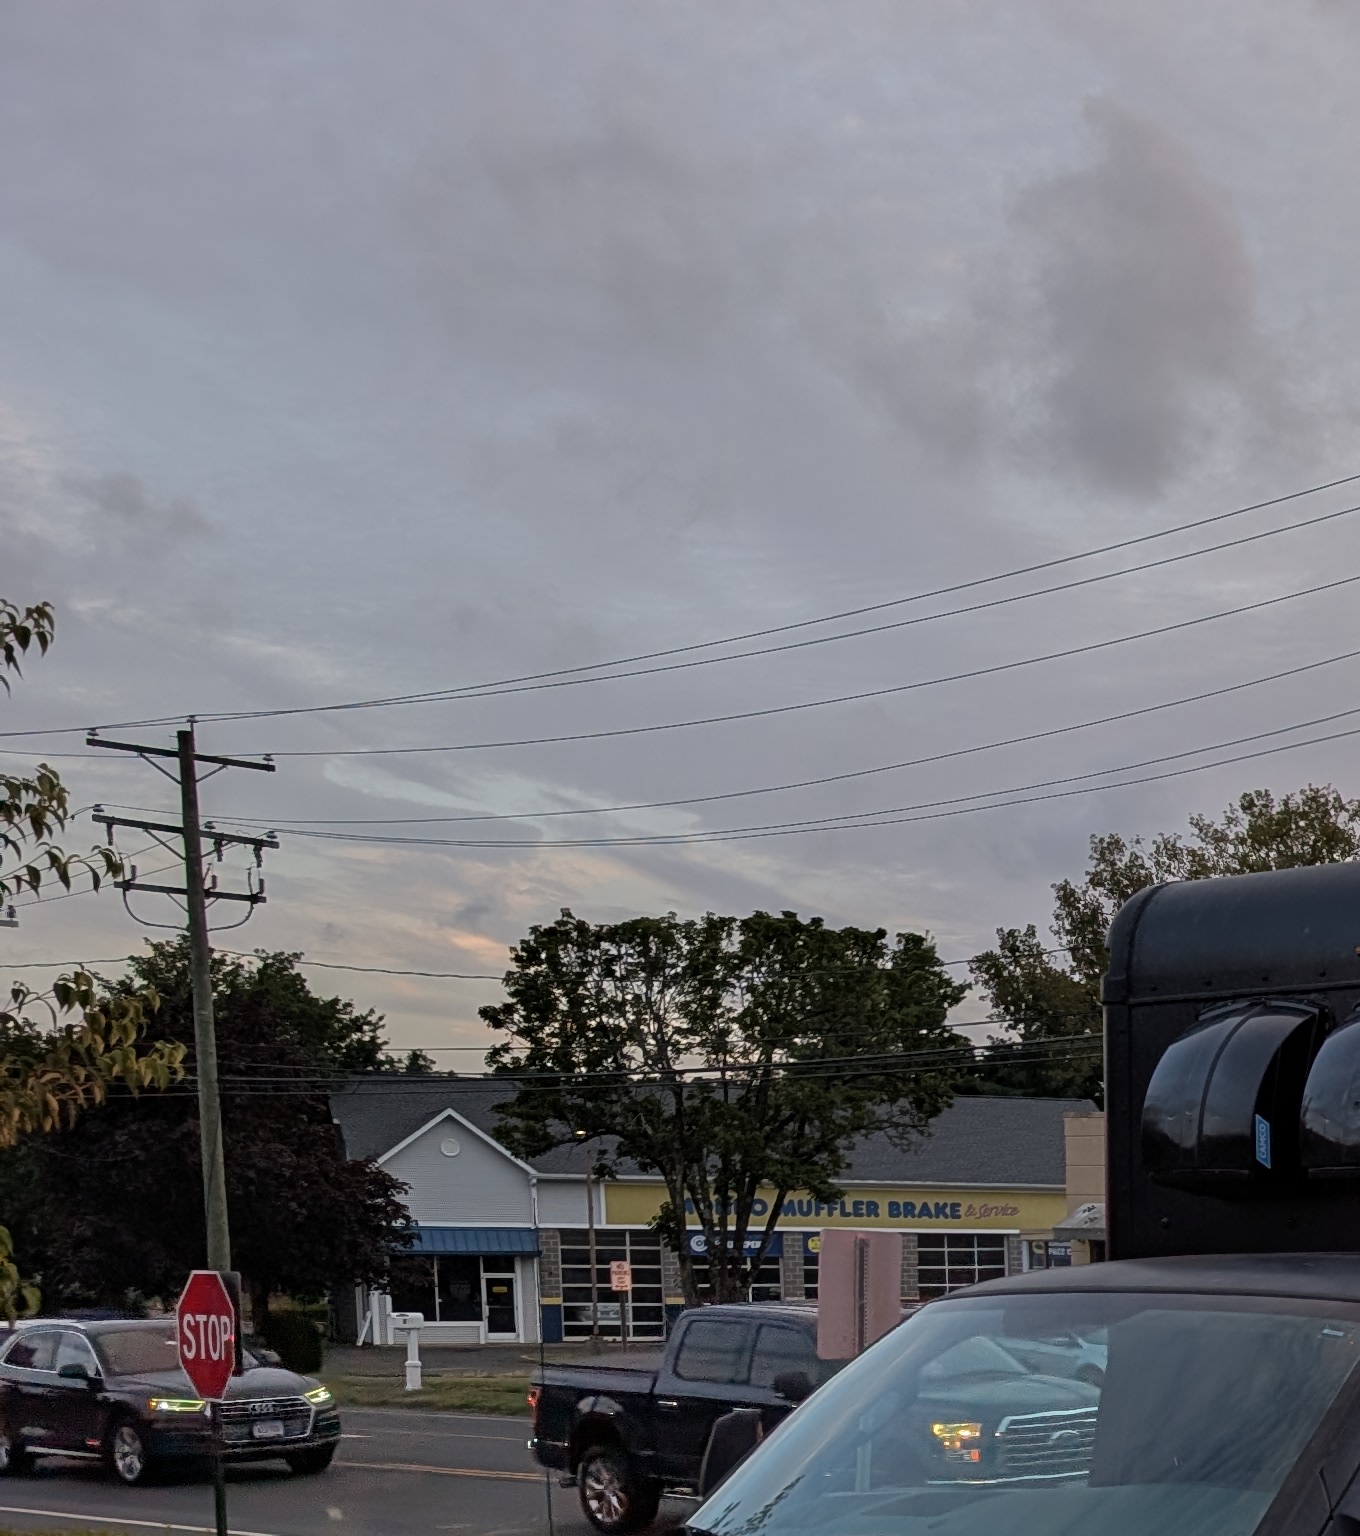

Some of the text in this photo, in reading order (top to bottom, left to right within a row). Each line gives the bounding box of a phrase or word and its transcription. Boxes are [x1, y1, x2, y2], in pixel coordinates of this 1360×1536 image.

[1259, 1123, 1267, 1159] CAMCO
[781, 1199, 880, 1218] MUFFLER
[888, 1200, 962, 1219] BRAKE
[183, 1313, 231, 1361] STOP
